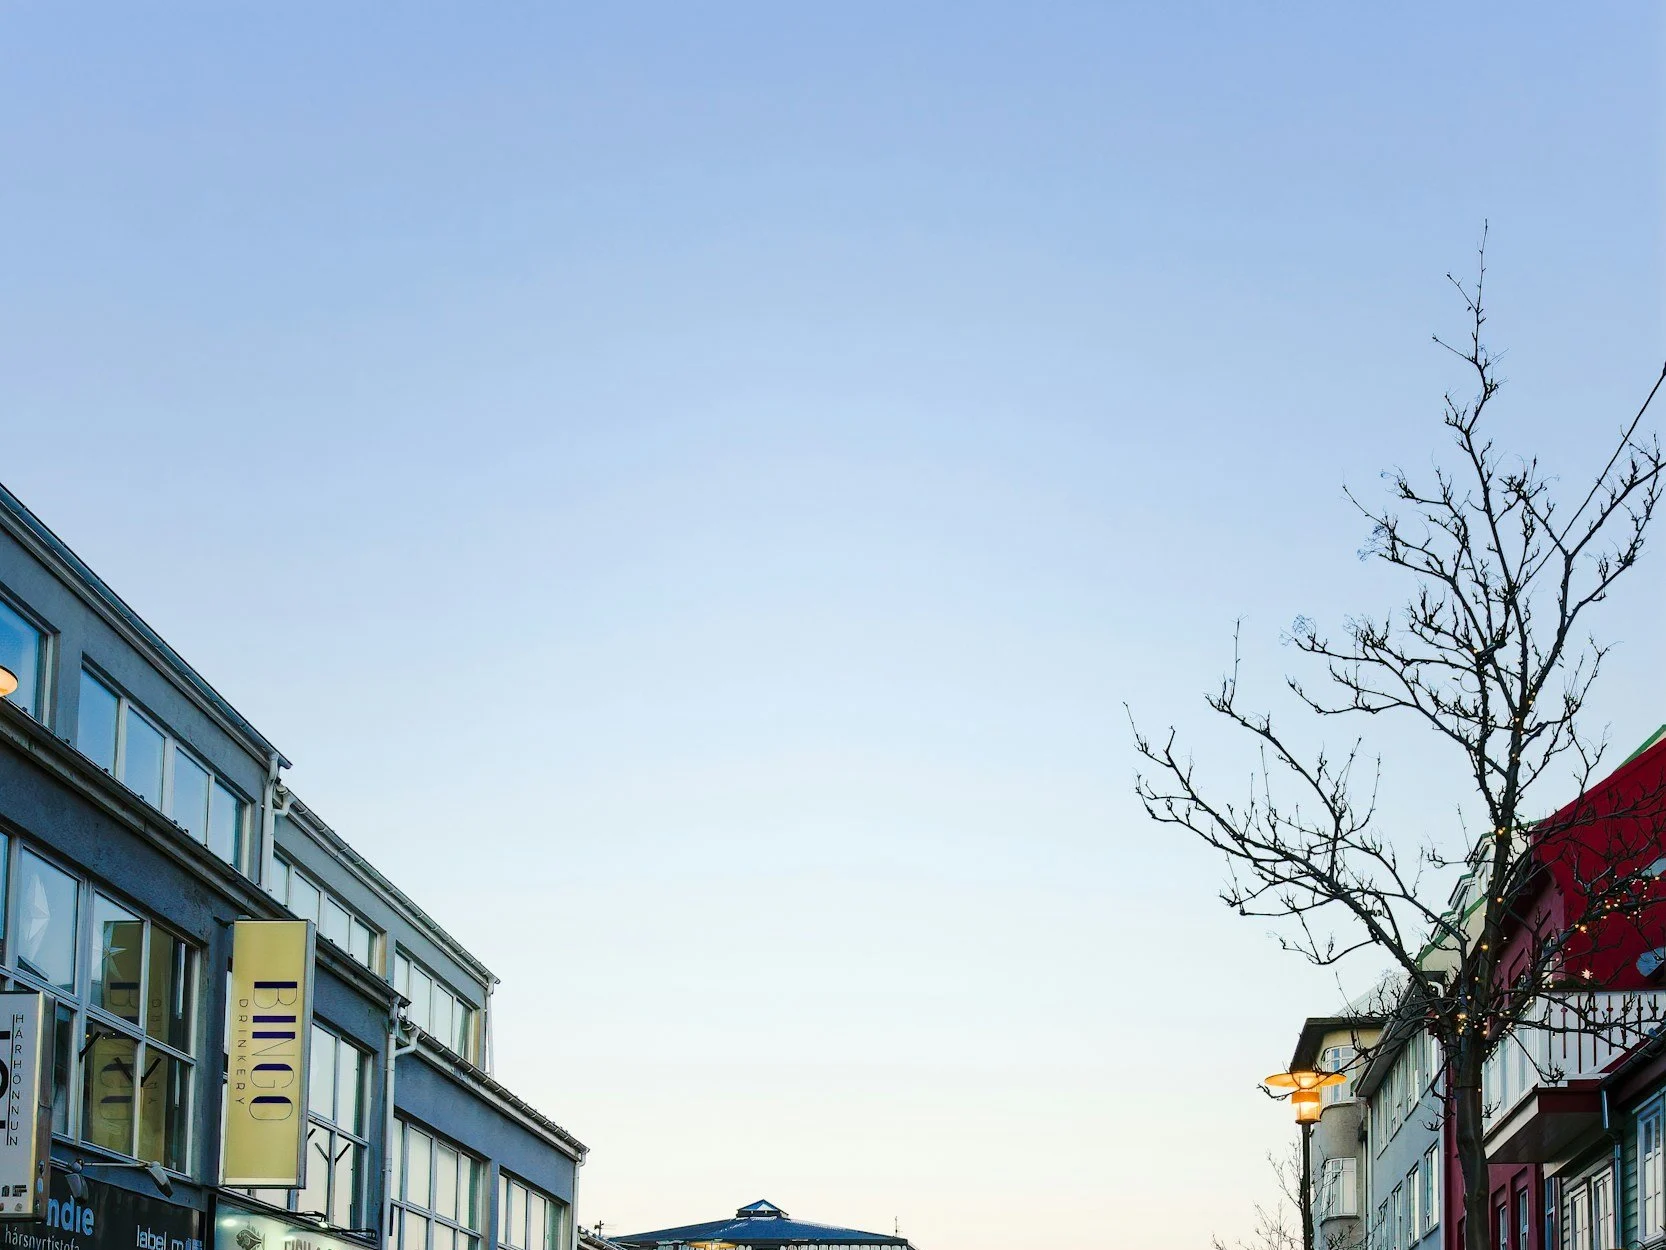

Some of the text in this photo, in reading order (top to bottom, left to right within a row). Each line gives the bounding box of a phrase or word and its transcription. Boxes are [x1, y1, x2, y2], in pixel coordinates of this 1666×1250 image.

[10, 1014, 24, 1146] HÁRHÖNNUN
[235, 997, 249, 1105] DRINKERY
[249, 981, 298, 1121] BINGO
